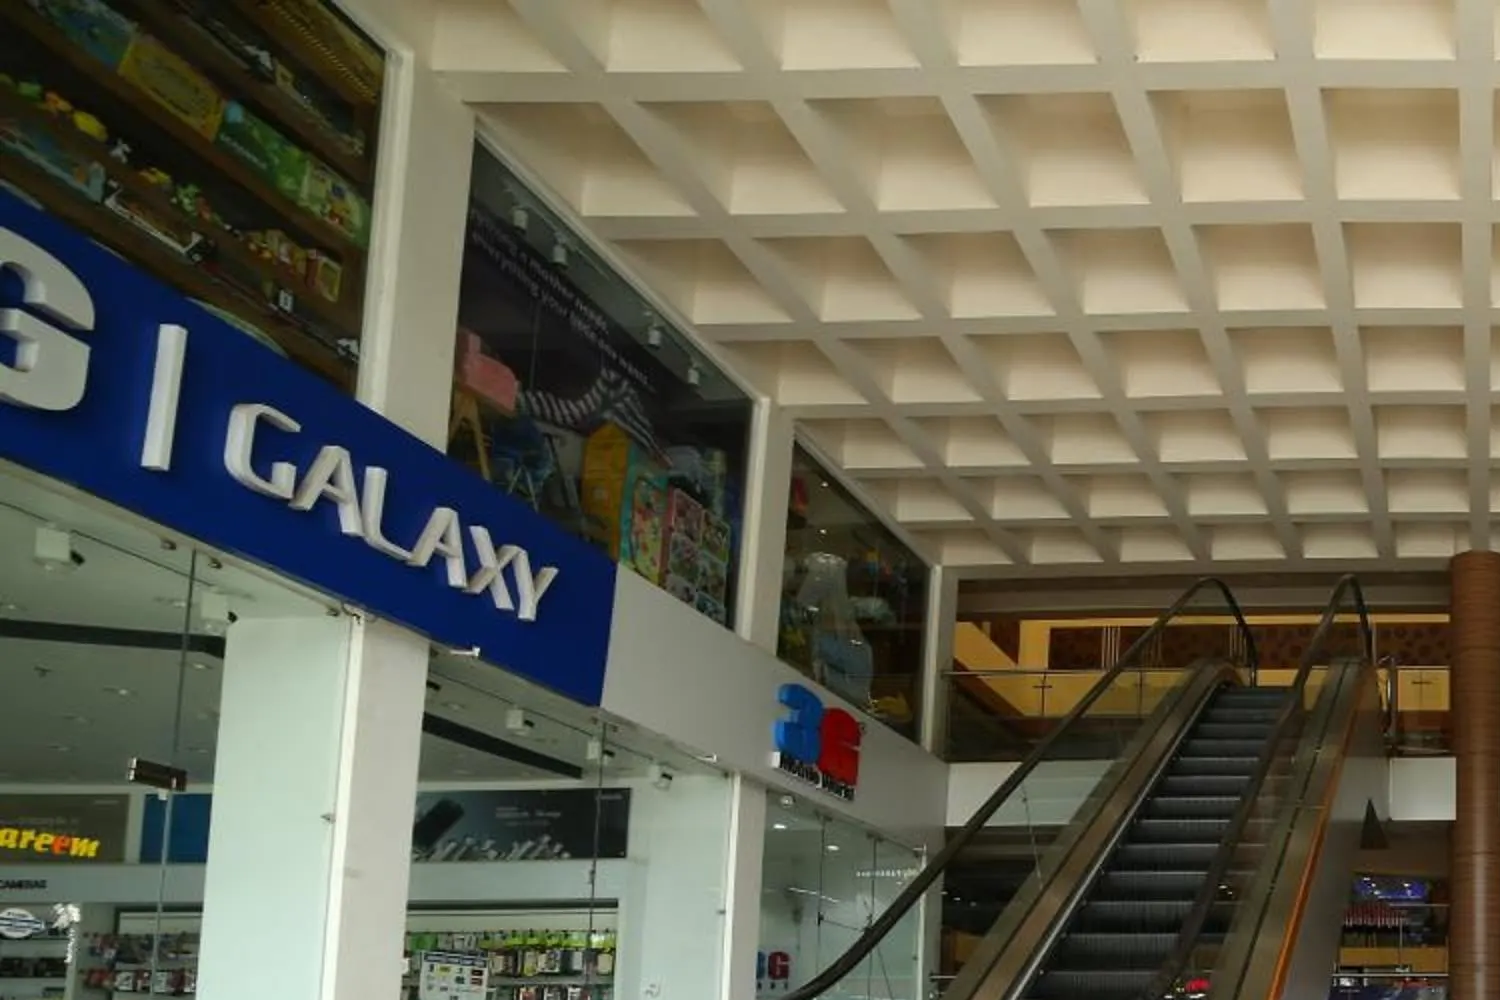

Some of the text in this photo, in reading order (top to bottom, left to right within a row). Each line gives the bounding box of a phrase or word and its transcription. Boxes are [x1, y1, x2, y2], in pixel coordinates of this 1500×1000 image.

[223, 403, 559, 621] GALAXY
[772, 682, 862, 787] 3G
[772, 750, 856, 802] Mobile World
